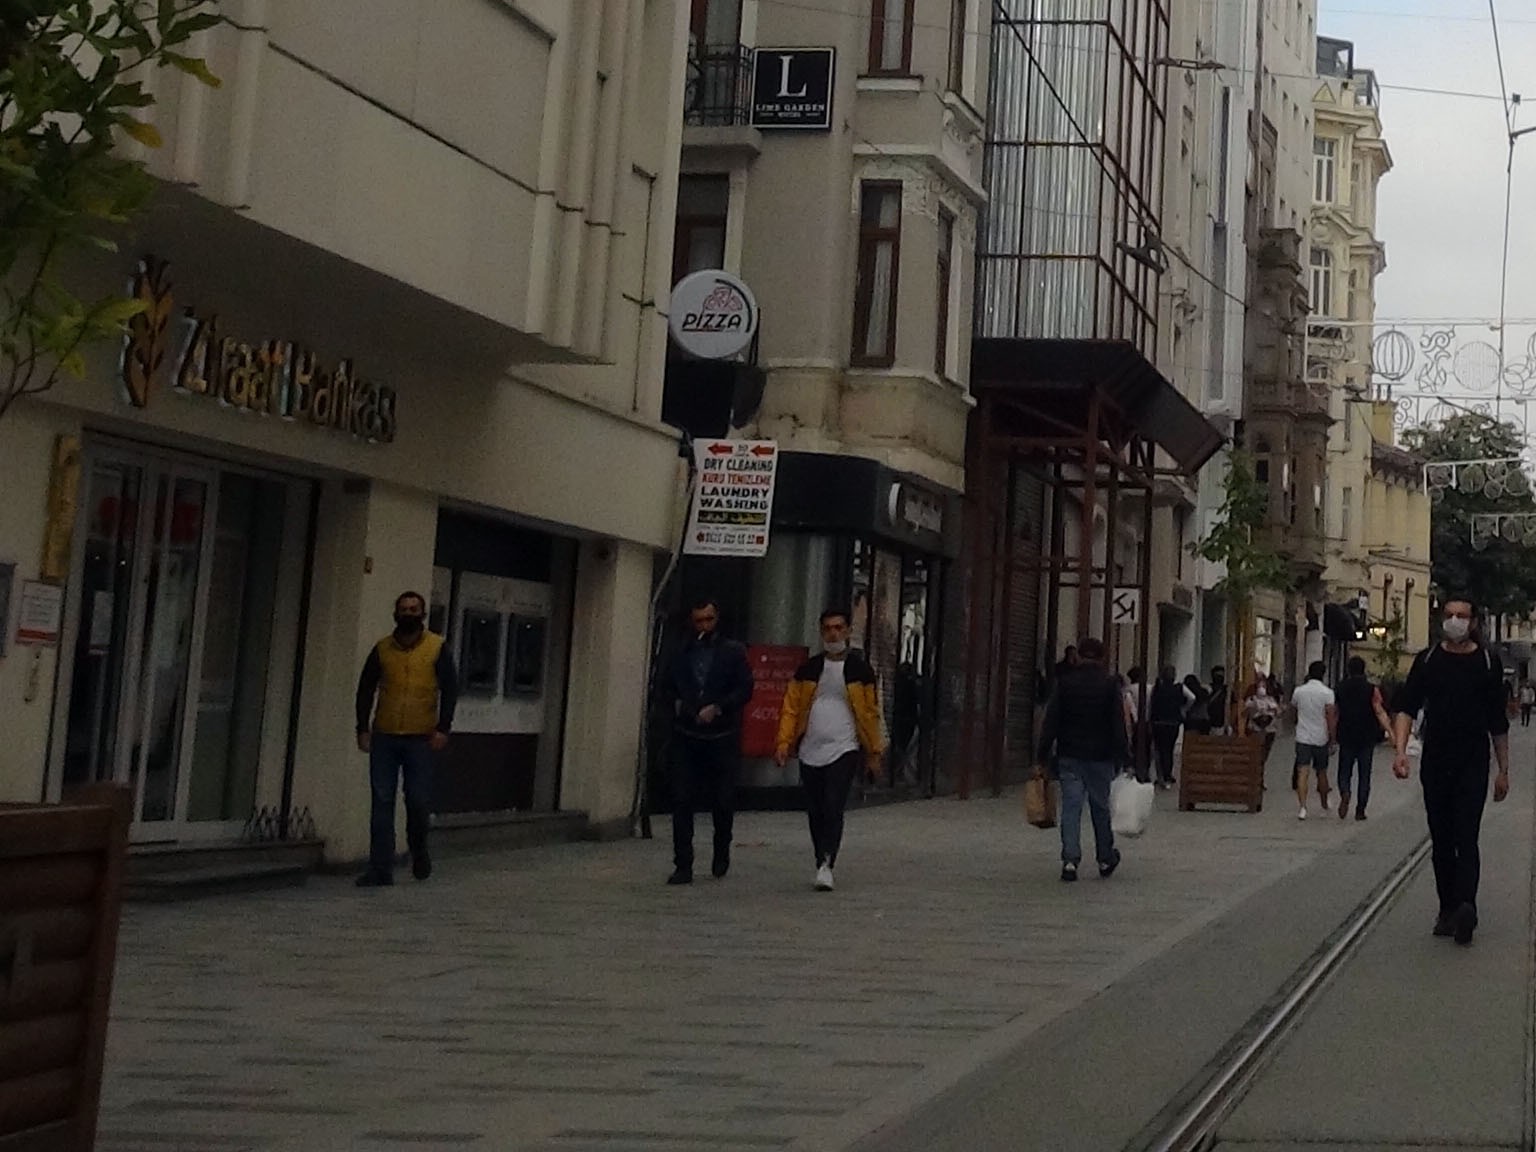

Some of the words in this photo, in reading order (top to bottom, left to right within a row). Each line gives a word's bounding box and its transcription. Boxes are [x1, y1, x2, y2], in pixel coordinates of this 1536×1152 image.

[776, 54, 807, 98] L
[783, 103, 825, 112] GARDEN
[682, 313, 742, 329] PIZZA
[171, 304, 296, 420] Ziraat
[704, 457, 724, 471] DRY
[726, 458, 774, 472] CLEANING
[700, 486, 770, 499] LAUNDRY
[699, 497, 768, 511] WASHING
